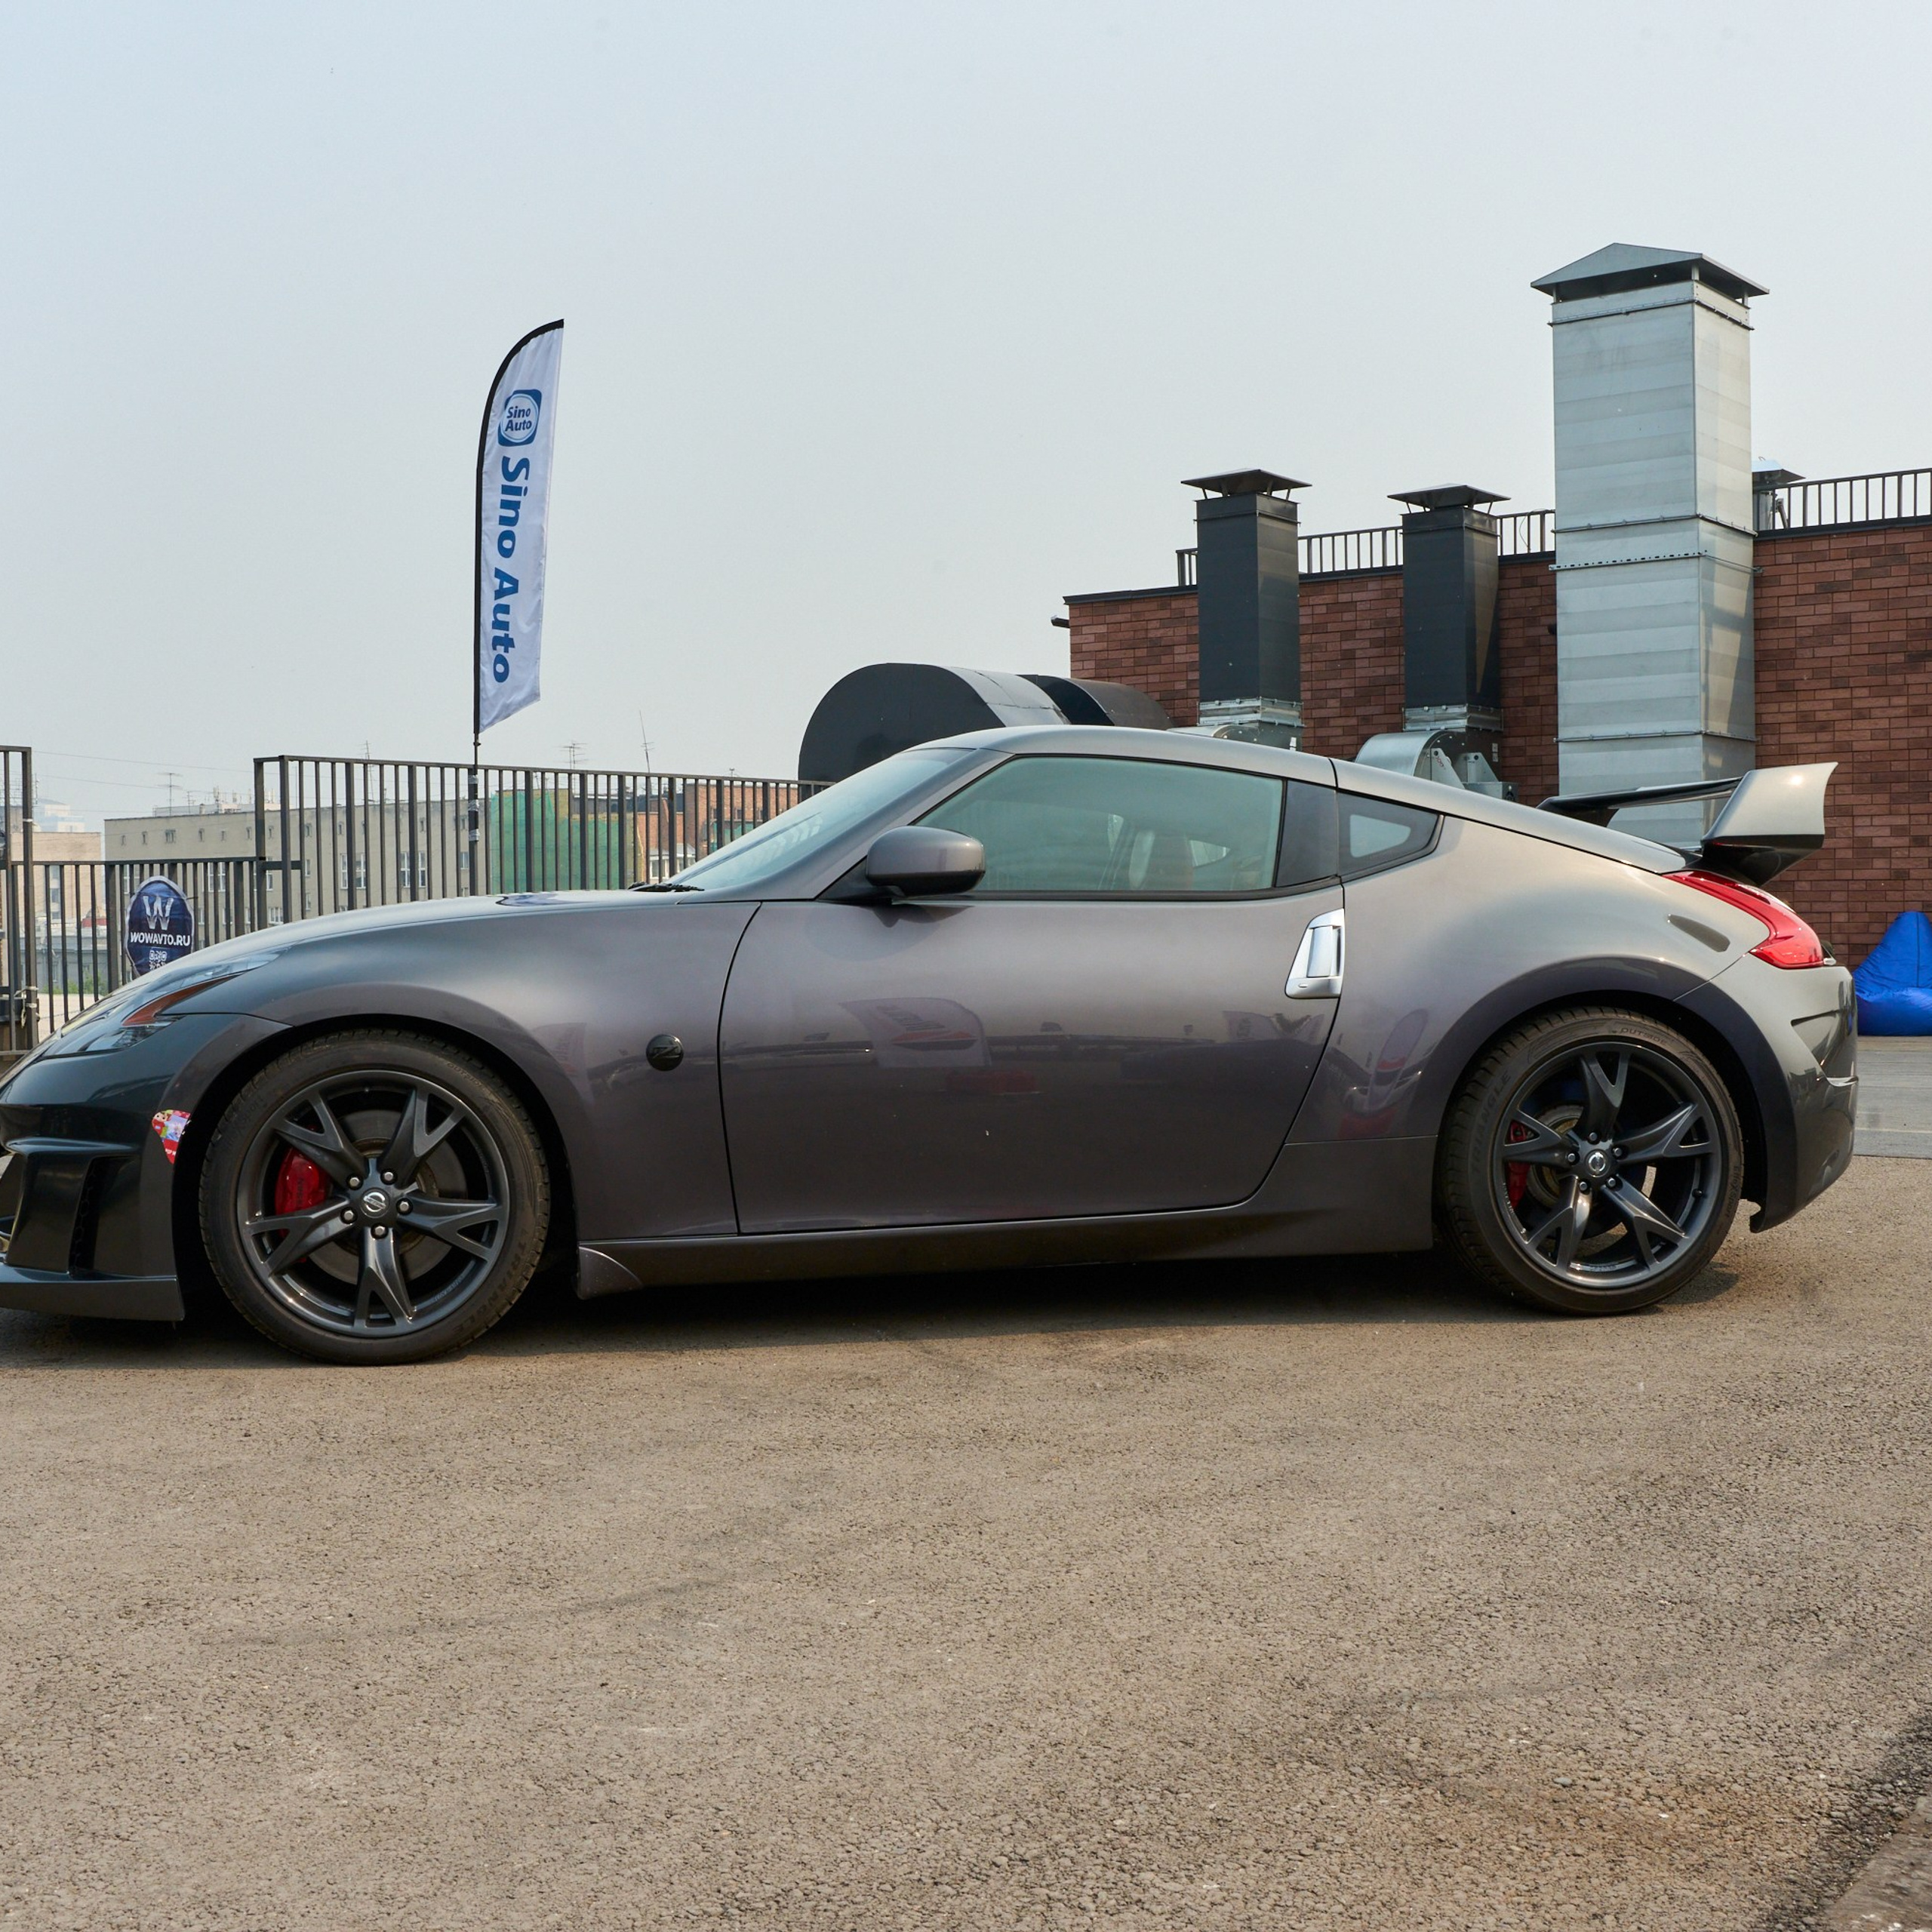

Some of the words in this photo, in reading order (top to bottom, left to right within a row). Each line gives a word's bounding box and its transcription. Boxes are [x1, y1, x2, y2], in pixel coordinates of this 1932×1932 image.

[506, 406, 531, 418] Sino
[505, 420, 532, 432] Auto
[497, 455, 530, 558] Sino
[491, 567, 519, 683] Auto
[143, 895, 174, 931] W
[130, 932, 190, 946] WOWAVTO.RU
